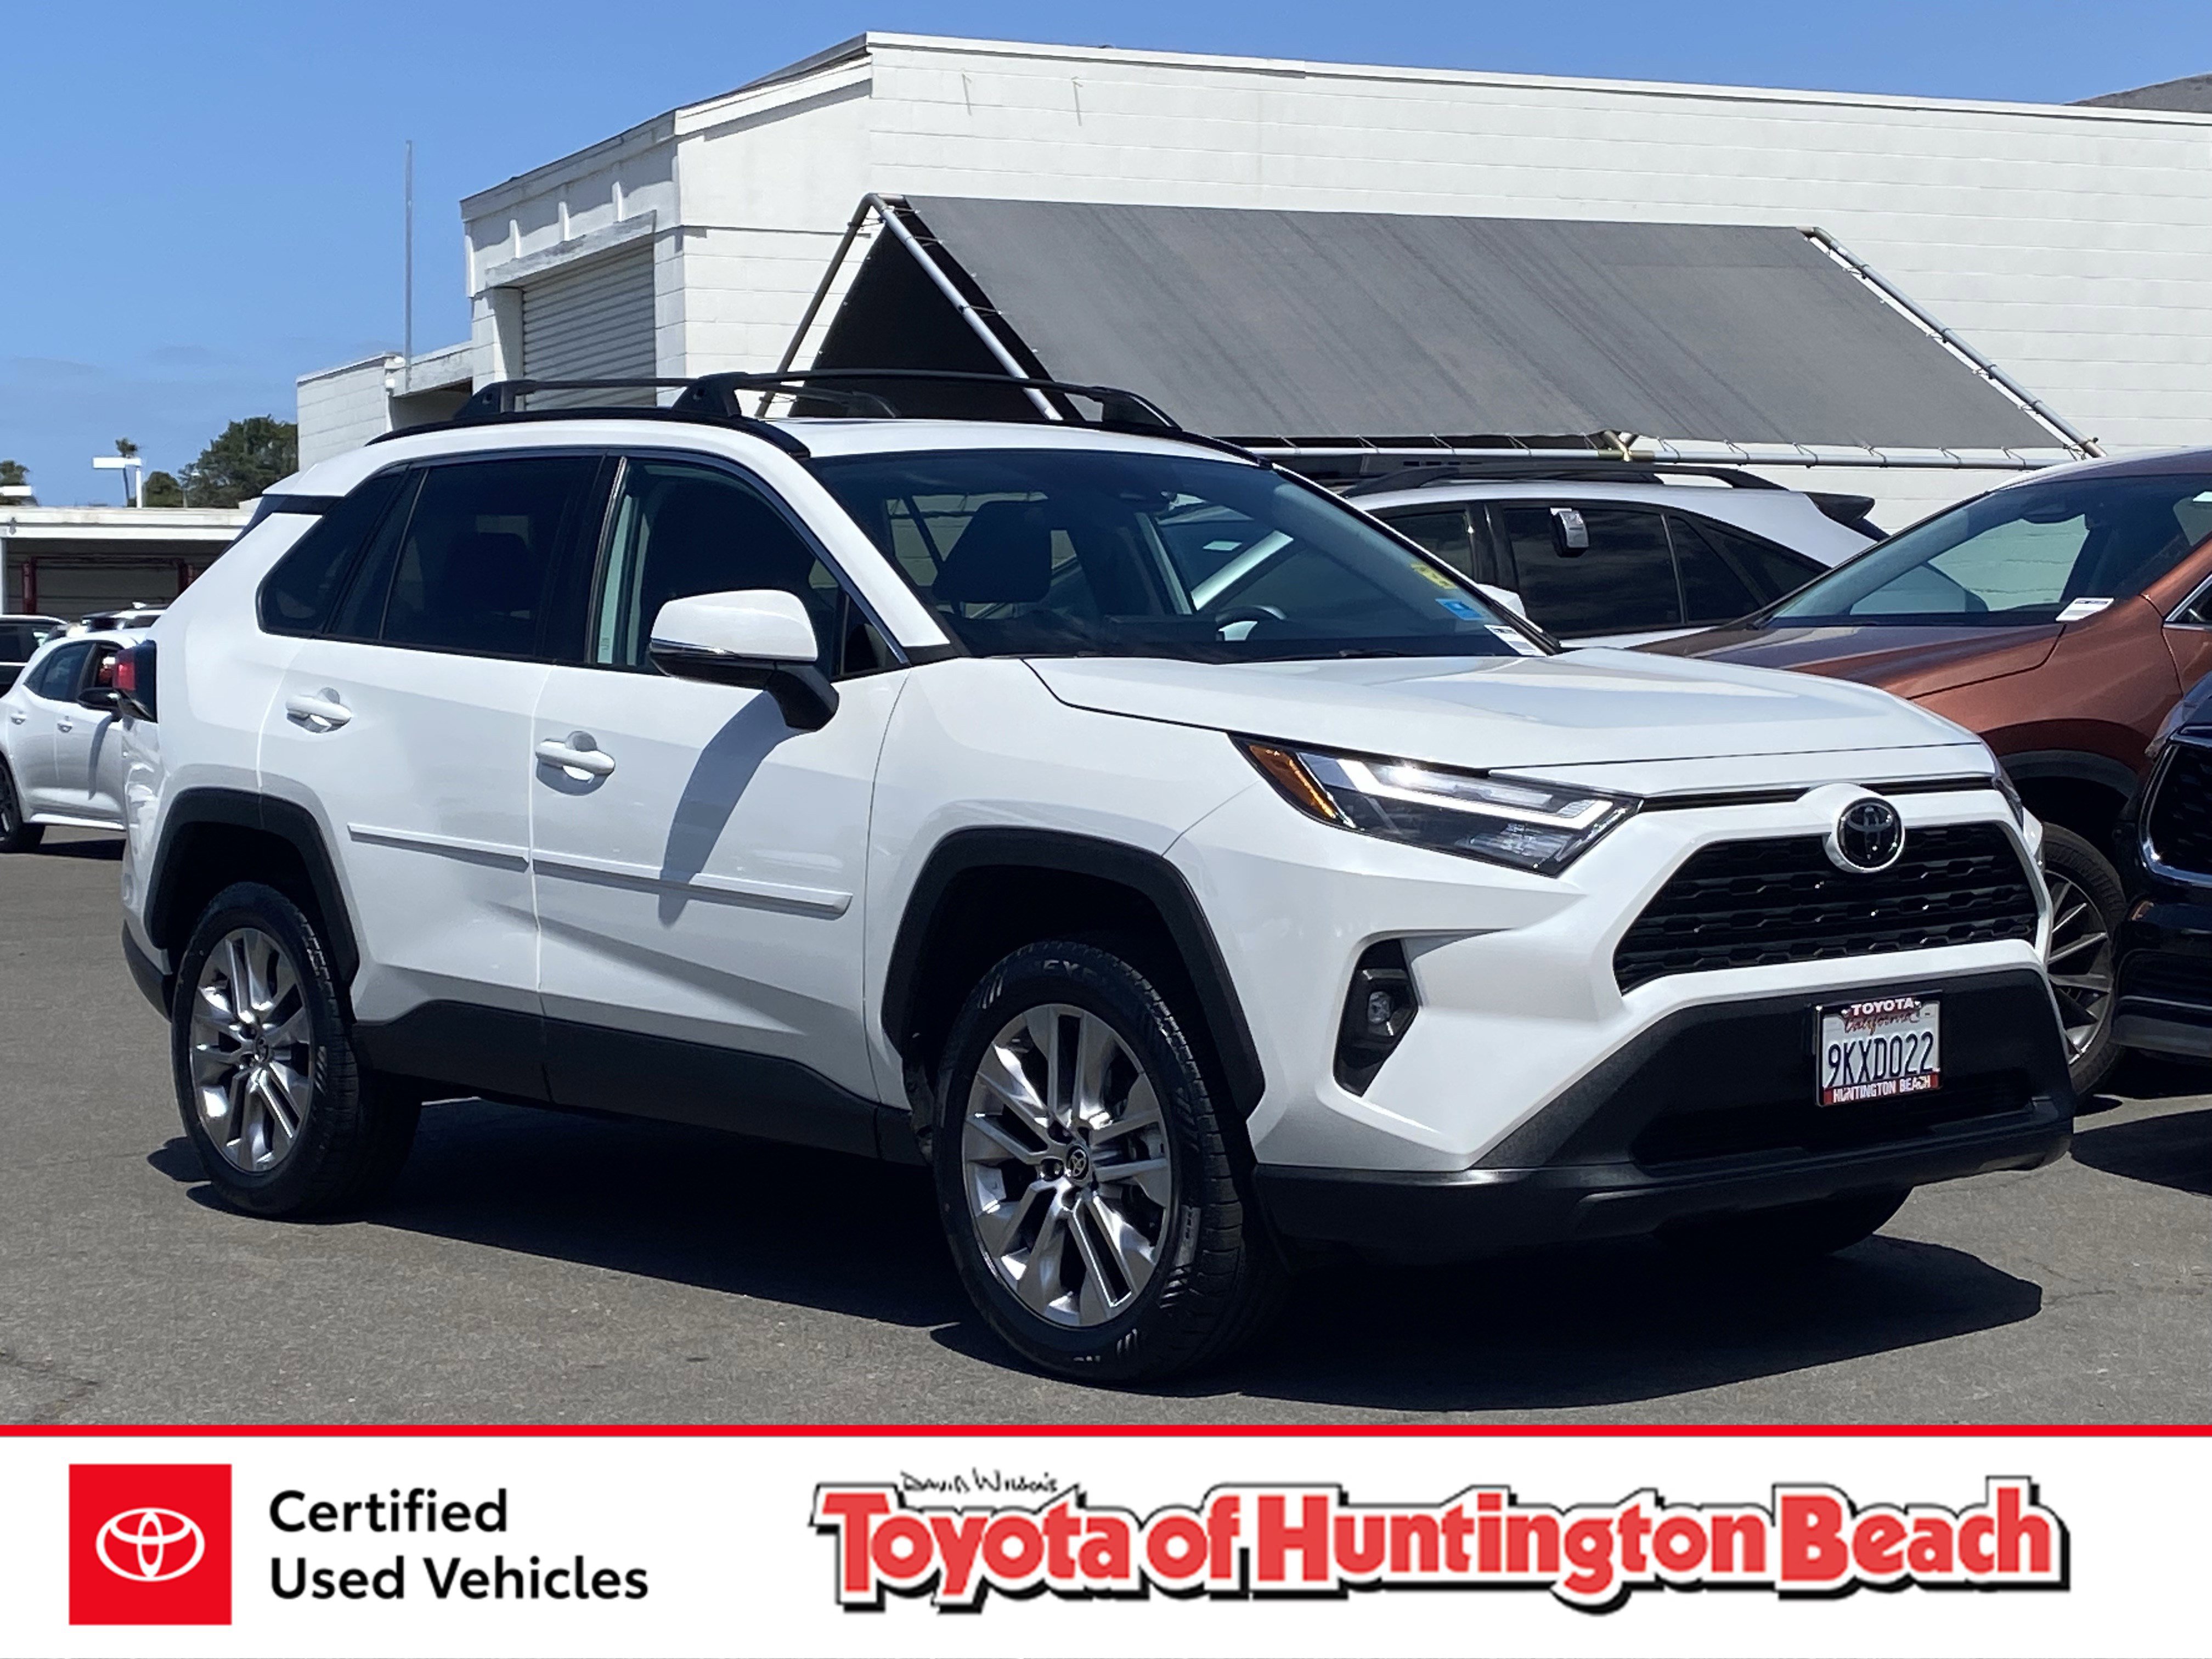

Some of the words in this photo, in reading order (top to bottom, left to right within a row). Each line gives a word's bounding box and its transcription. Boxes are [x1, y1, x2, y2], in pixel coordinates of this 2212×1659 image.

[1850, 997, 1914, 1015] TOYOTA
[1828, 1031, 1934, 1088] 9KXD022
[1833, 1080, 1896, 1103] HUNTINGTON
[1899, 1074, 1931, 1093] BEACH
